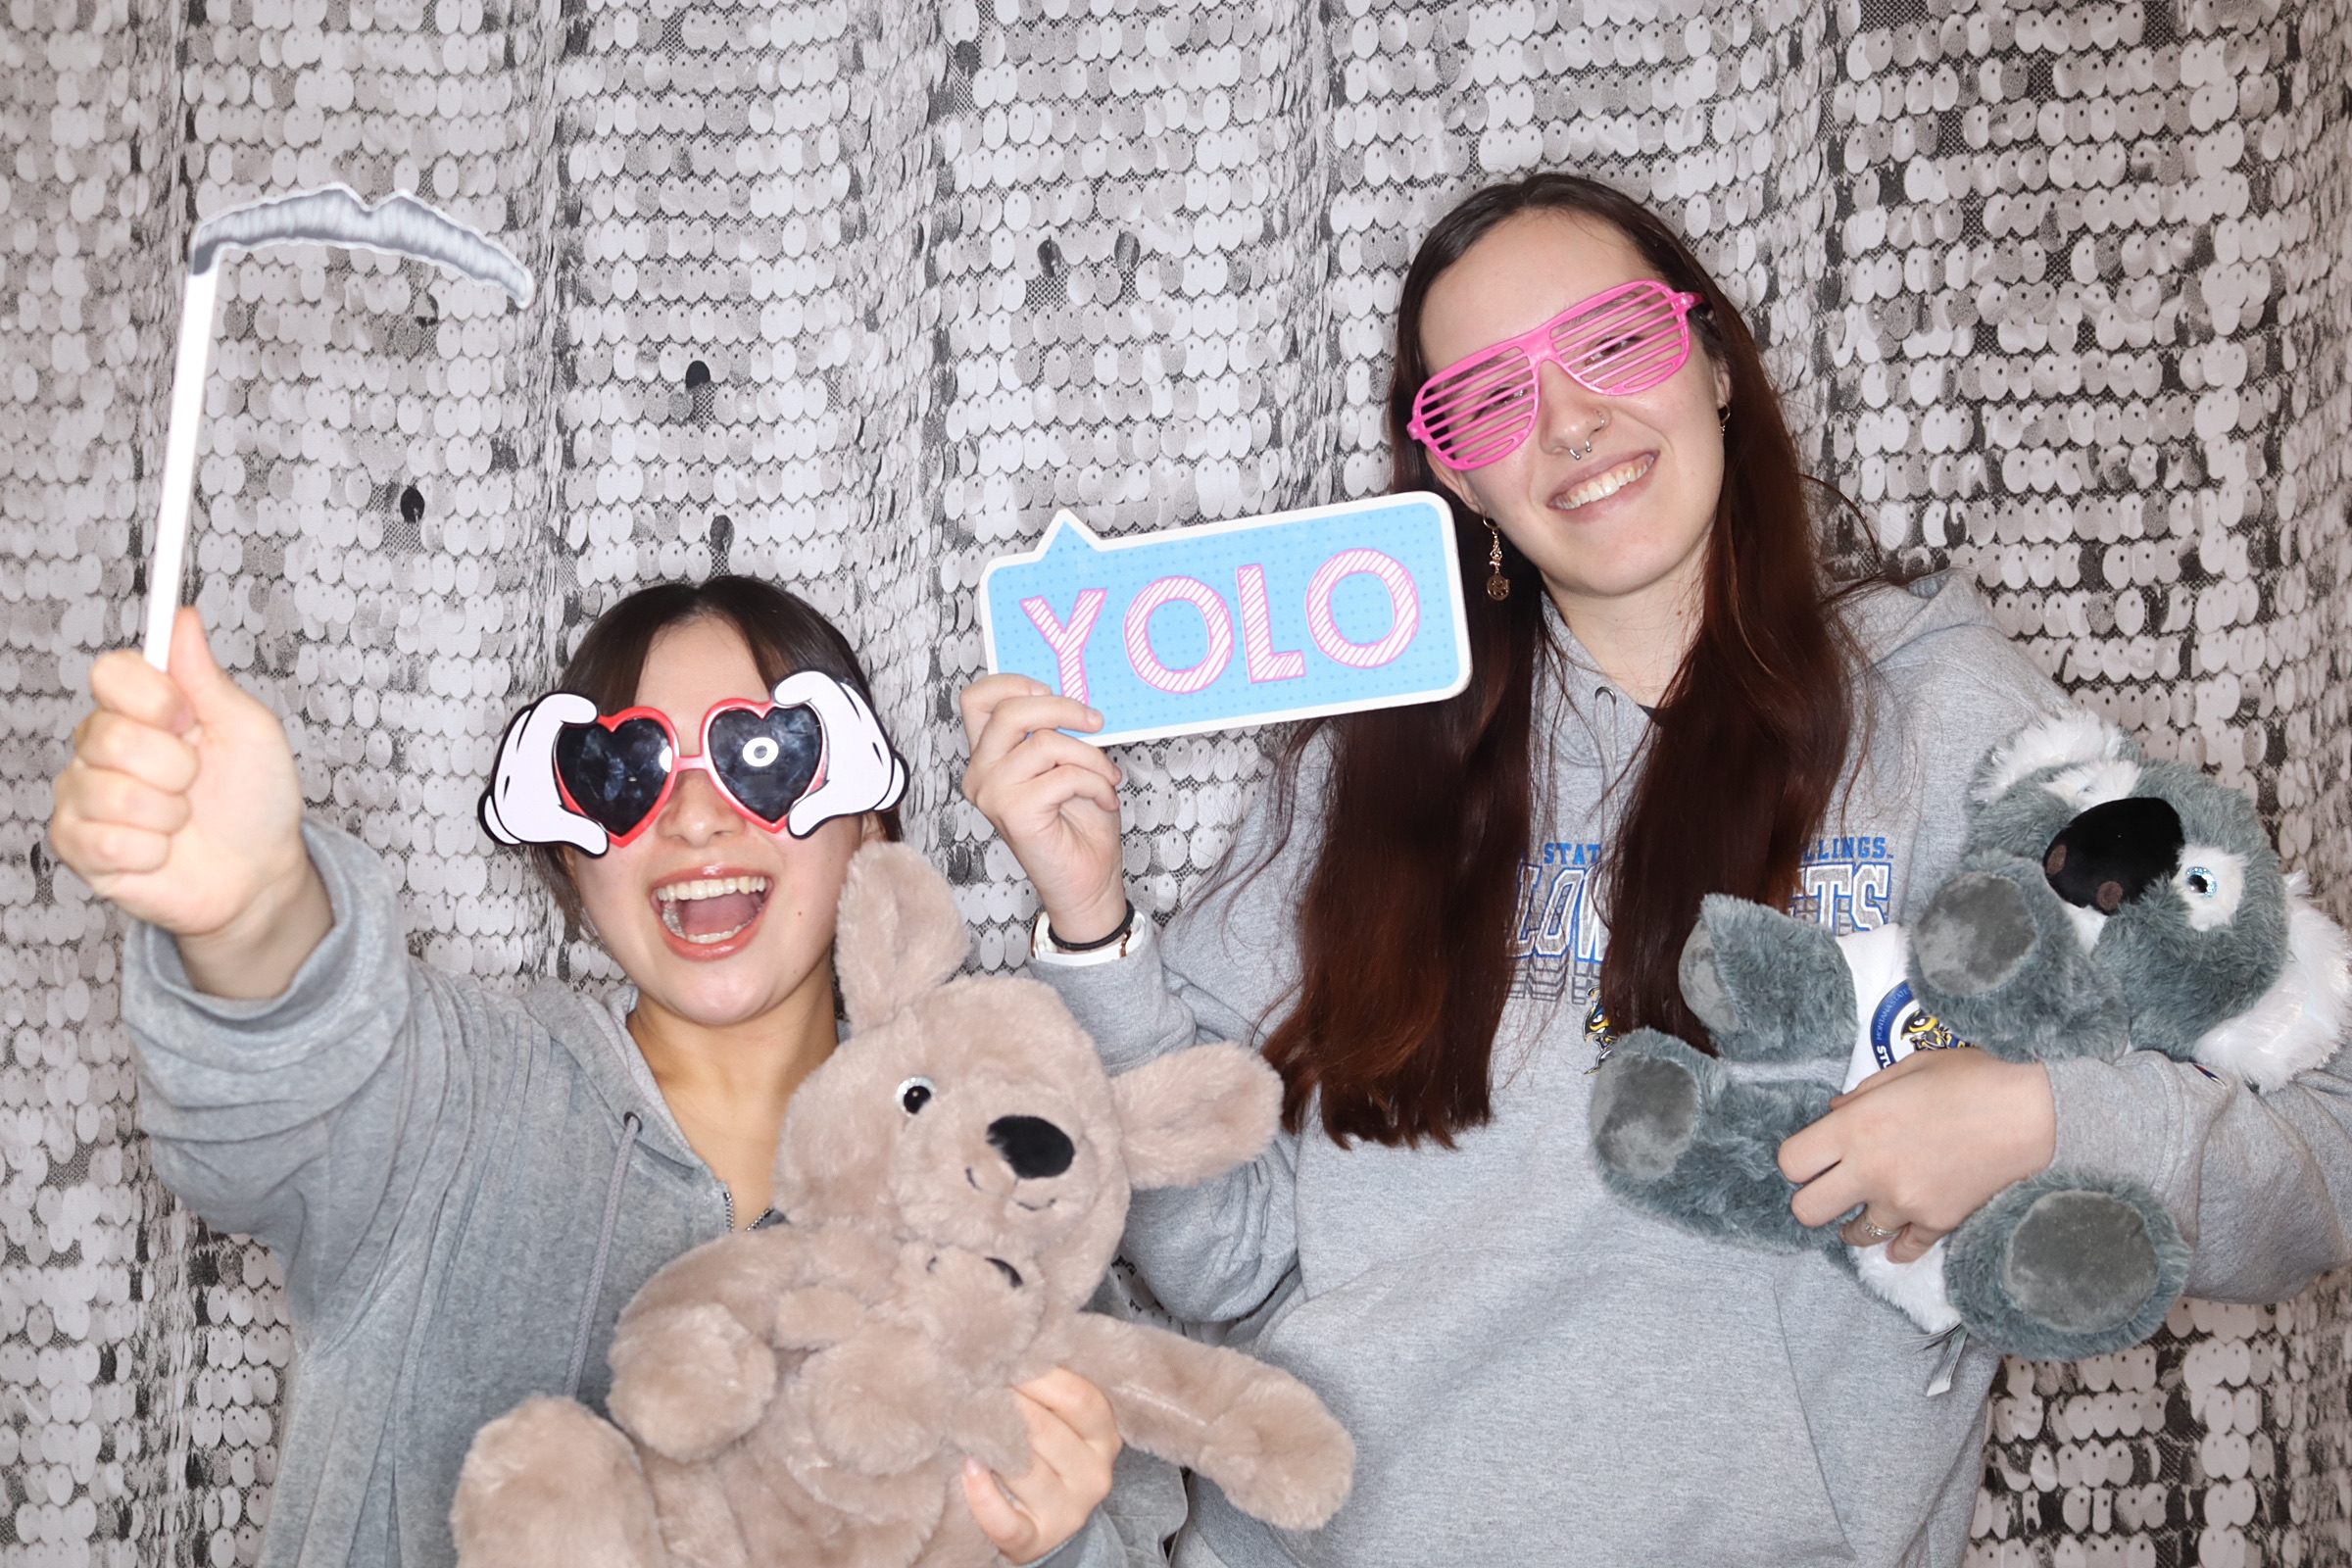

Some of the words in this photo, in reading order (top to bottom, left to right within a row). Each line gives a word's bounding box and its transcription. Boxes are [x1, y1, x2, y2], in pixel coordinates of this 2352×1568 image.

[1019, 547, 1420, 707] YOLO
[1544, 842, 1602, 865] STAT
[1802, 836, 1886, 862] LLINGS
[1876, 1004, 1893, 1041] MONTANA
[1889, 988, 1909, 1006] STATE
